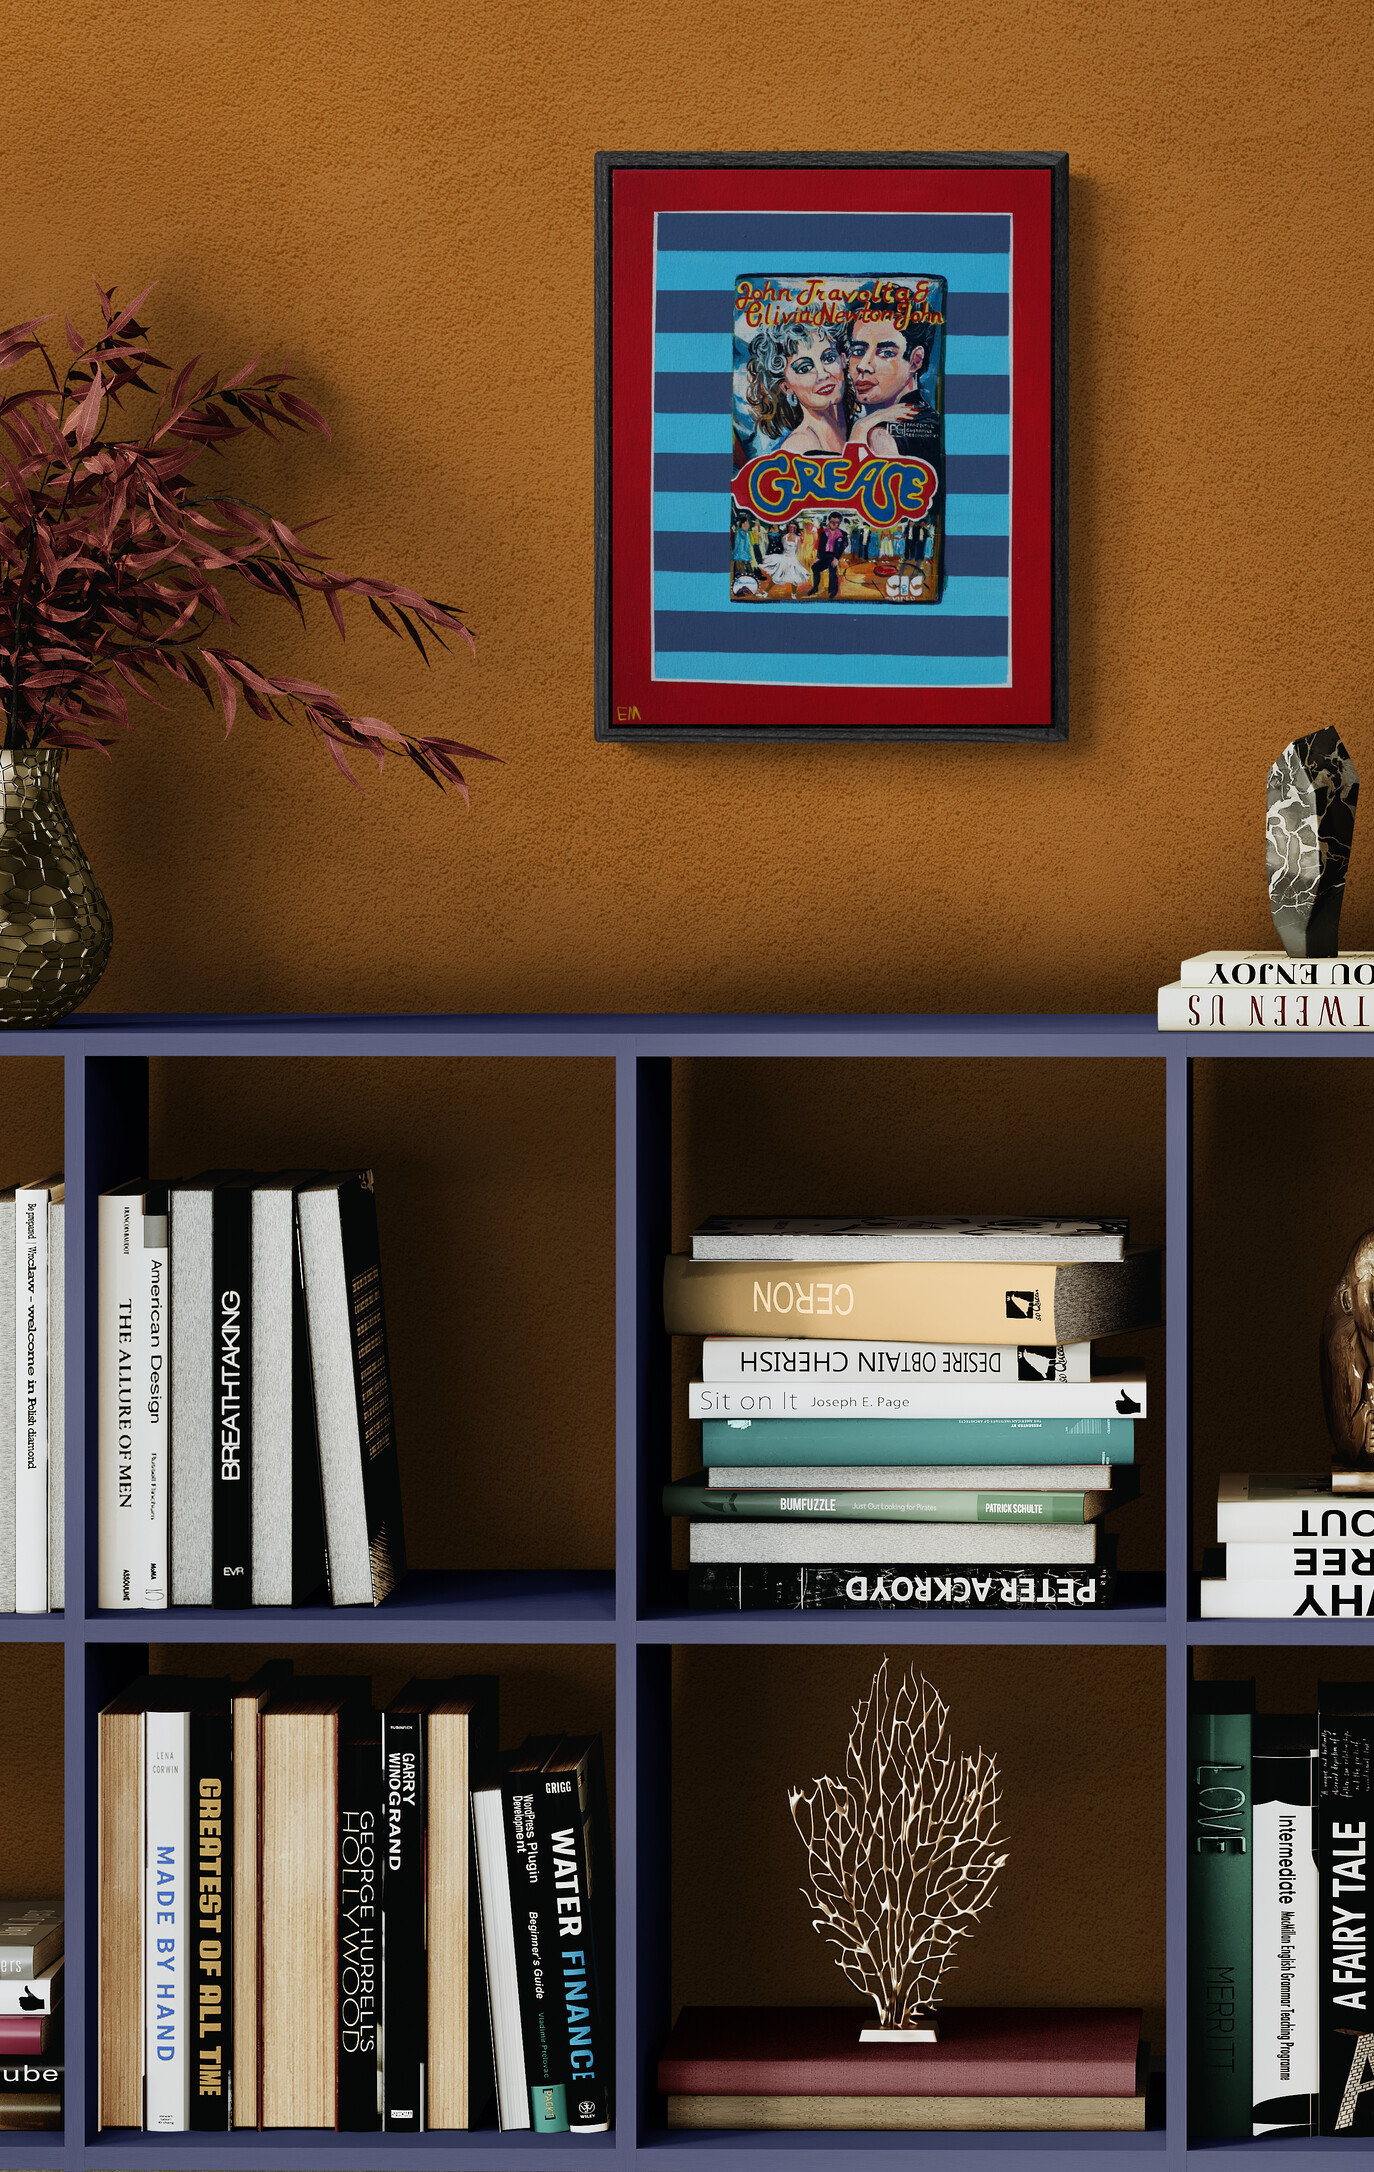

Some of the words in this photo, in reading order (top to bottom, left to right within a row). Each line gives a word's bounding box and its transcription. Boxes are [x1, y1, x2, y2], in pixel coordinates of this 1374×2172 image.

[736, 280, 793, 310] John
[795, 279, 912, 306] Travolta
[912, 280, 930, 303] &
[745, 302, 814, 327] Olivia
[814, 302, 944, 331] Newton-John
[750, 453, 929, 524] GREASE
[886, 575, 922, 596] CIC
[617, 706, 641, 721] EM
[1208, 963, 1318, 985] ENJOY
[1188, 994, 1226, 1027] US
[150, 1259, 162, 1348] American
[753, 1281, 854, 1316] CERON
[119, 1298, 132, 1344] THE
[28, 1304, 36, 1376] welcome
[741, 1352, 848, 1372] CHERISH
[858, 1352, 936, 1372] OBTAIN
[942, 1352, 1001, 1372] DESIRE
[28, 1380, 36, 1394] in
[119, 1350, 132, 1430] ALLURE
[148, 1354, 162, 1424] Design
[221, 1290, 240, 1480] BREATHTAKING
[700, 1390, 730, 1410] Sit
[740, 1395, 772, 1410] on
[783, 1392, 798, 1410] It
[28, 1397, 36, 1426] Polish
[810, 1396, 857, 1409] Joseph
[862, 1396, 873, 1408] E.
[878, 1396, 910, 1409] Page
[28, 1428, 36, 1470] diamond
[119, 1434, 132, 1460] OF
[119, 1465, 132, 1508] MEN
[780, 1498, 836, 1511] BUMFUZZLE
[852, 1502, 866, 1510] Just
[868, 1502, 880, 1510] Out
[880, 1503, 905, 1512] Looking
[985, 1503, 1012, 1513] PATRICK
[1012, 1504, 1043, 1514] SCHULTE
[223, 1566, 244, 1576] EVR
[845, 1576, 992, 1602] ACKROYD
[1000, 1578, 1096, 1603] PETER
[152, 1765, 179, 1774] CORWIN
[156, 1752, 174, 1760] LENA
[402, 1753, 416, 1806] GARRY
[546, 1781, 572, 1794] GRIGG
[388, 1752, 402, 1871] WINOGRAND
[512, 1795, 527, 1854] Development
[522, 1794, 537, 1838] WordPress
[1197, 1765, 1247, 1854] LOVE
[199, 1778, 222, 1933] GREATEST
[360, 1810, 375, 1918] GEORGE
[526, 1842, 541, 1884] Plugin
[1278, 1815, 1296, 1904] Intermediate
[1332, 1821, 1366, 1898] TALE
[156, 1846, 176, 1925] MADE
[550, 1828, 584, 1936] WATER
[342, 1811, 360, 2054] HOLLYWOOD
[528, 1911, 543, 1967] Beginner's
[1280, 1911, 1294, 1943] MacMillan
[156, 1938, 176, 1972] BY
[199, 1940, 222, 1976] OF
[1278, 1945, 1294, 1971] English
[1332, 1905, 1366, 1984] FAIRY
[360, 1928, 376, 2053] HURRELL'S
[532, 1968, 546, 2000] Guide
[1280, 1973, 1295, 2007] Grammar
[1332, 1990, 1366, 2010] A
[156, 1984, 176, 2062] HAND
[199, 1984, 222, 2038] ALL
[538, 2012, 547, 2042] Vladimir
[561, 1950, 596, 2080] FINANCE
[1206, 1966, 1235, 2074] MERRITT
[1278, 2009, 1295, 2040] Teaching
[3, 2064, 58, 2082] ube
[199, 2045, 222, 2096] TIME
[541, 2044, 550, 2078] Prelovac
[1277, 2042, 1294, 2080] Programme
